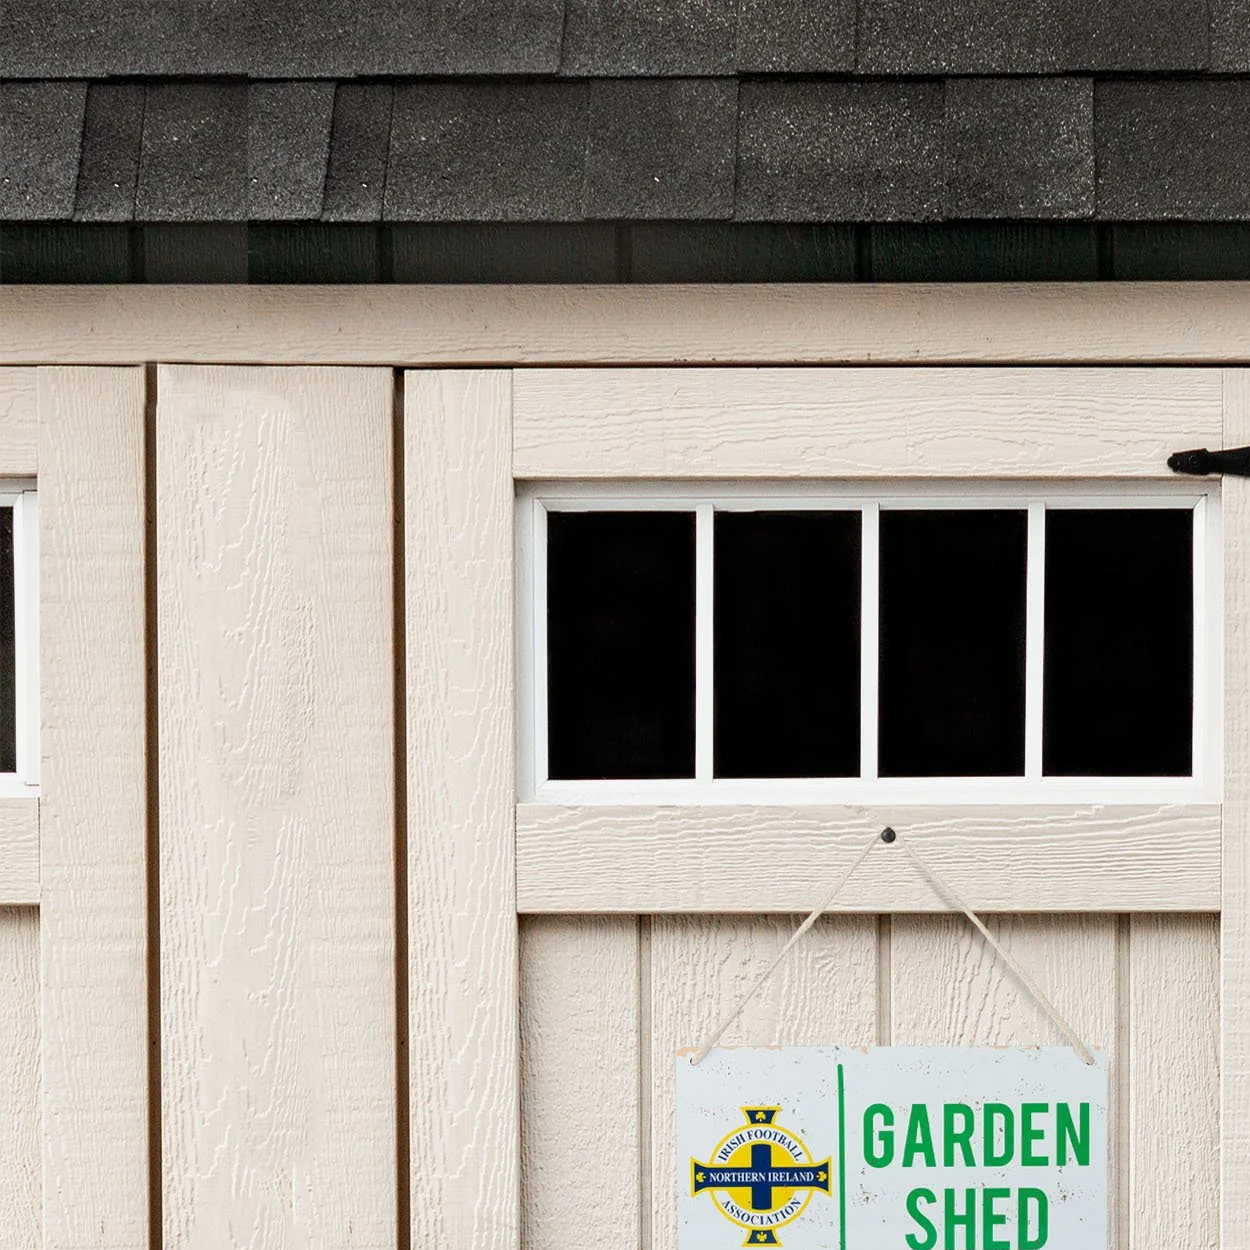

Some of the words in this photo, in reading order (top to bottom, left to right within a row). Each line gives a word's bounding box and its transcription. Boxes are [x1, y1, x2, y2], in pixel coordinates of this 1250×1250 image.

[718, 1133, 746, 1162] IRISH
[747, 1129, 803, 1162] FOOTBALL
[863, 1102, 1090, 1168] GARDEN
[709, 1171, 766, 1183] NORTHERN
[768, 1171, 814, 1182] IRELAND
[721, 1198, 802, 1225] ASSOCIATION
